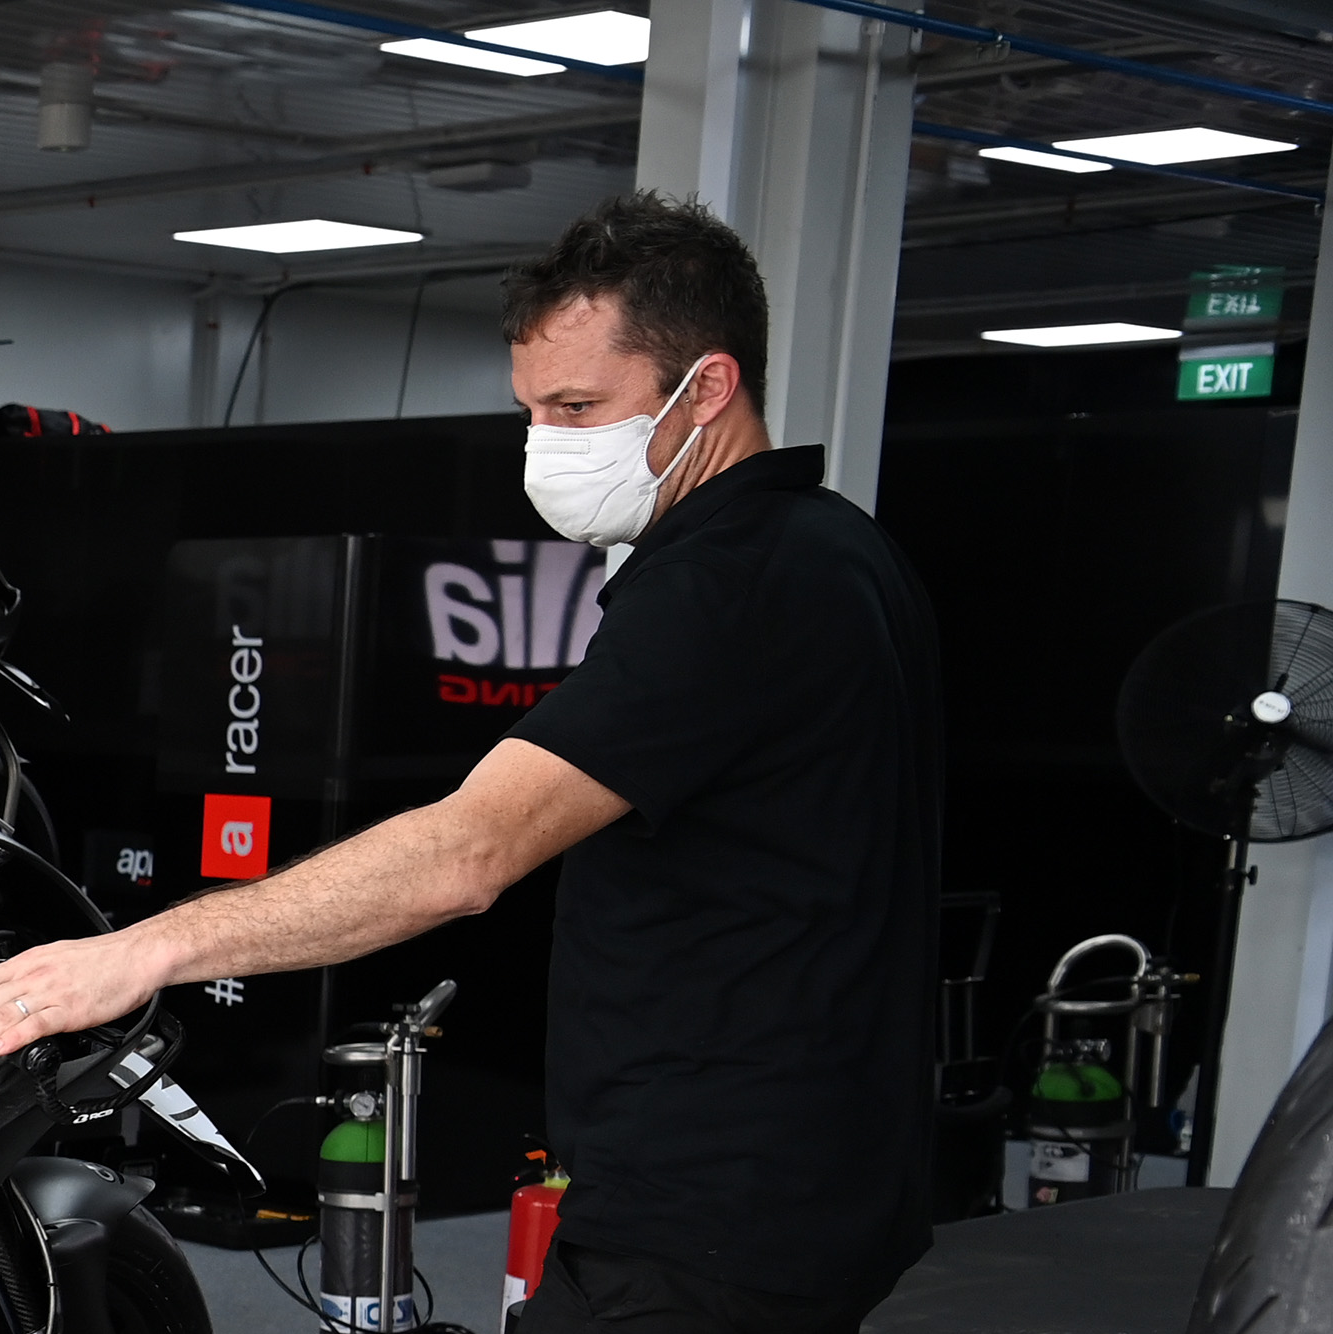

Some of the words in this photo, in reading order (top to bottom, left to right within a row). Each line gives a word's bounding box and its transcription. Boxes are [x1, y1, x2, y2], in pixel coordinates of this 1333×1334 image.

[1196, 362, 1254, 394] EXIT
[225, 624, 263, 775] racer
[221, 820, 254, 857] a
